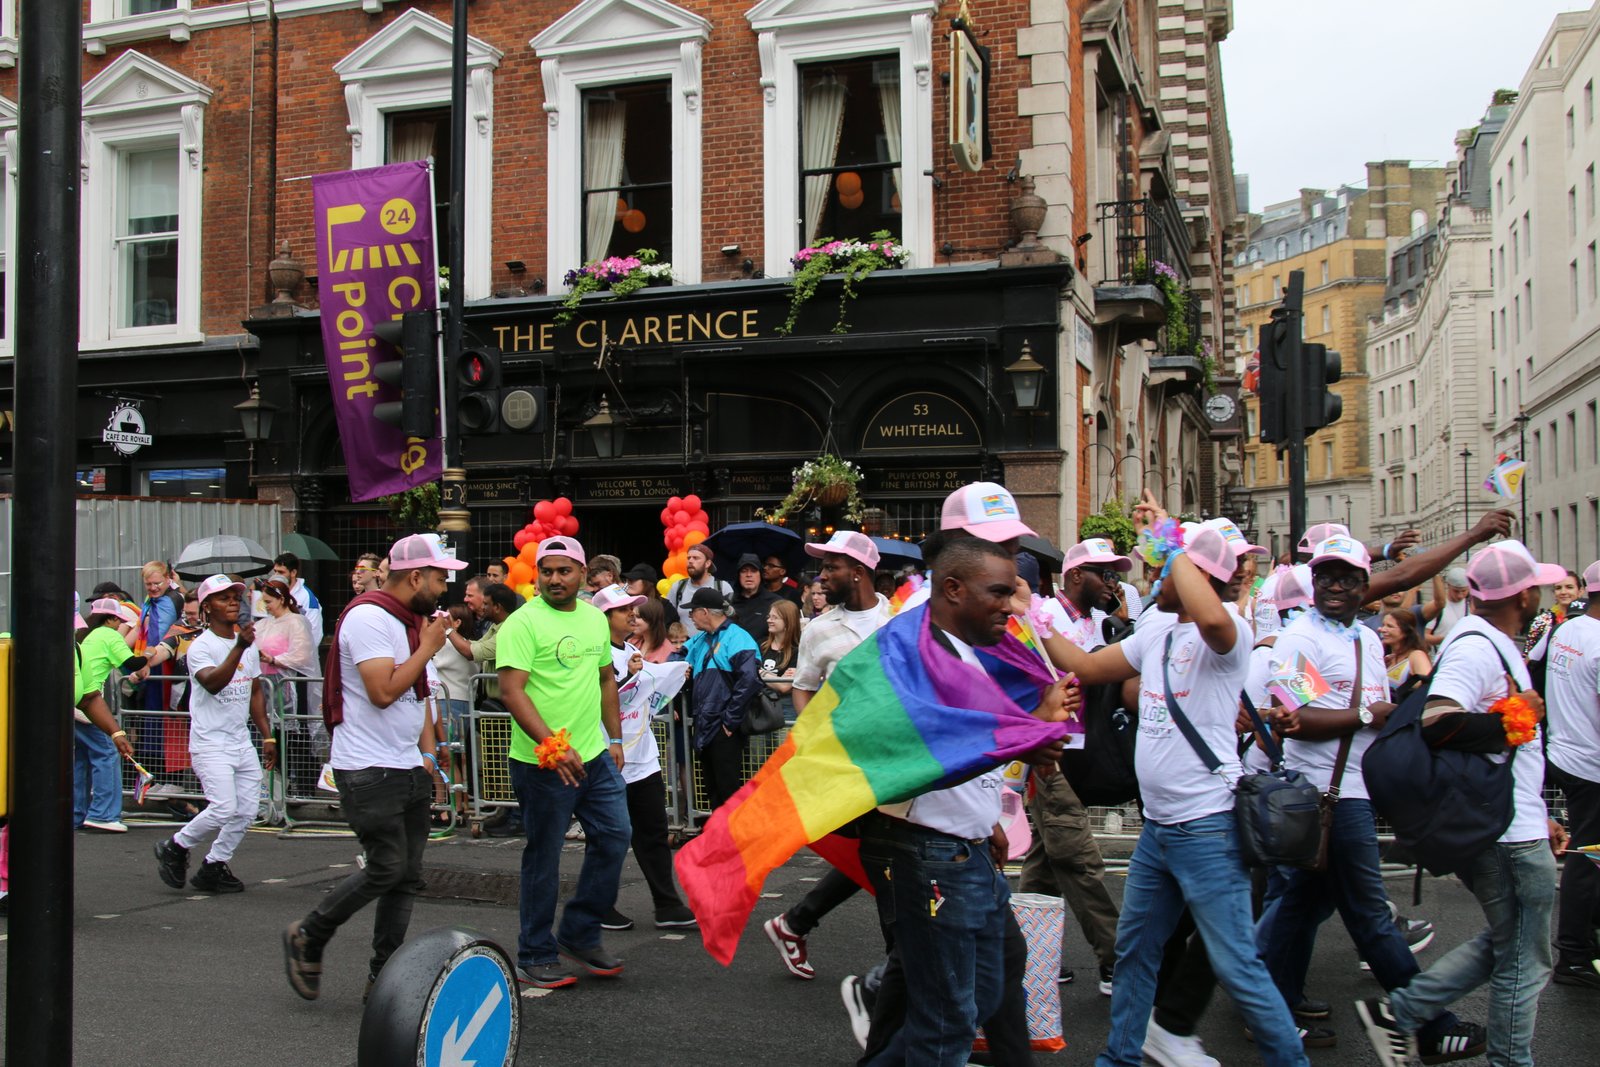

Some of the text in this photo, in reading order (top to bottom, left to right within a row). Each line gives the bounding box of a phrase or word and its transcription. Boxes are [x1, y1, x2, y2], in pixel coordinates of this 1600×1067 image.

[385, 207, 411, 226] 24
[493, 309, 759, 352] THE CLARENCE
[332, 281, 379, 400] Point
[913, 404, 929, 416] 53
[880, 423, 964, 437] WHITEHALL
[121, 434, 129, 442] DE
[130, 435, 150, 444] ROYALE
[732, 475, 765, 484] FAMOUS
[888, 471, 958, 480] PURVEYORS OF
[497, 482, 517, 490] SINCE
[596, 479, 671, 489] WELCOME TO ALL
[880, 480, 900, 489] FINE
[904, 480, 939, 489] BRITISH
[589, 487, 680, 497] VISITORS TO LONDON
[1570, 600, 1586, 609] NY
